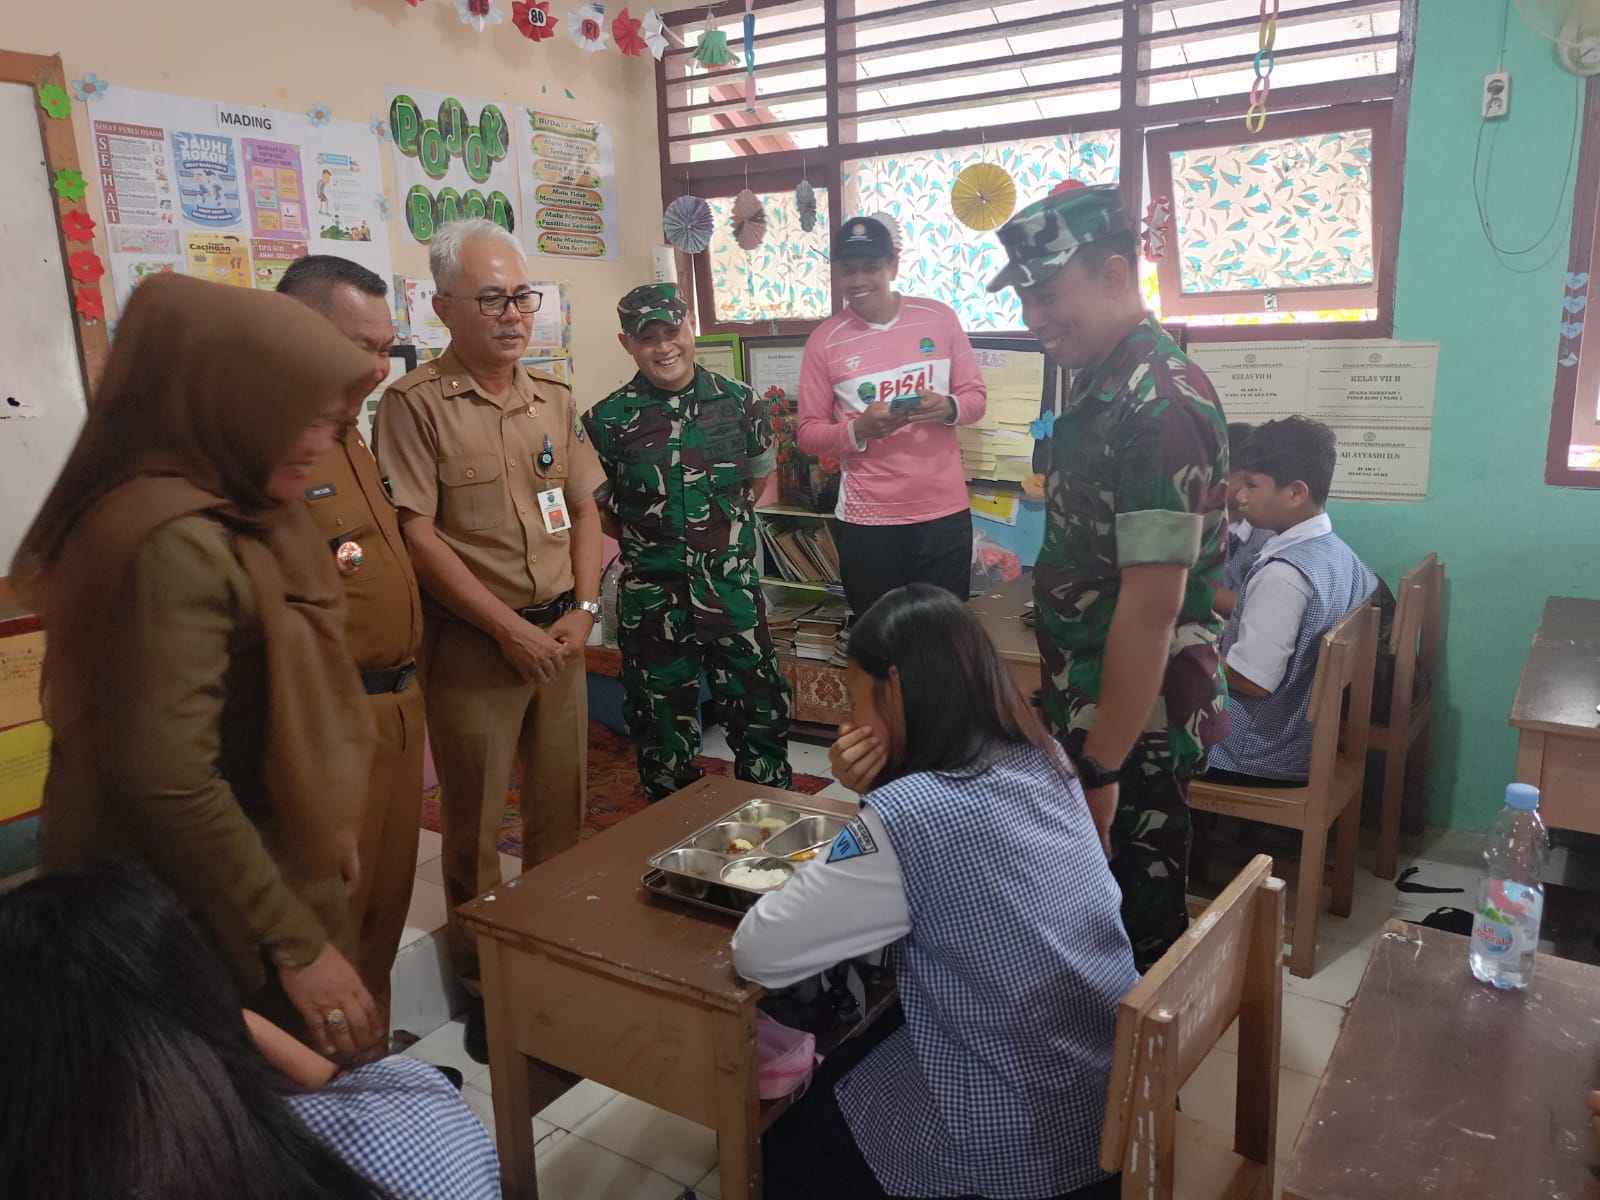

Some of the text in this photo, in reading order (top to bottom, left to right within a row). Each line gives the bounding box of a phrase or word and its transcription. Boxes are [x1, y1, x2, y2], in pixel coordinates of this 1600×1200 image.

[531, 9, 544, 24] 80
[586, 22, 597, 37] RI
[221, 111, 272, 130] MADING
[178, 134, 227, 155] JAUHI
[395, 101, 506, 181] POJOK
[181, 149, 228, 166] ROKOK
[552, 188, 587, 199] Malu Tidak
[539, 195, 600, 209] Mengerjakan Tugas
[544, 211, 564, 220] Malu
[546, 234, 563, 243] Malu
[189, 243, 231, 252] Cacingan
[879, 364, 934, 402] BISA!
[1483, 922, 1495, 934] Le
